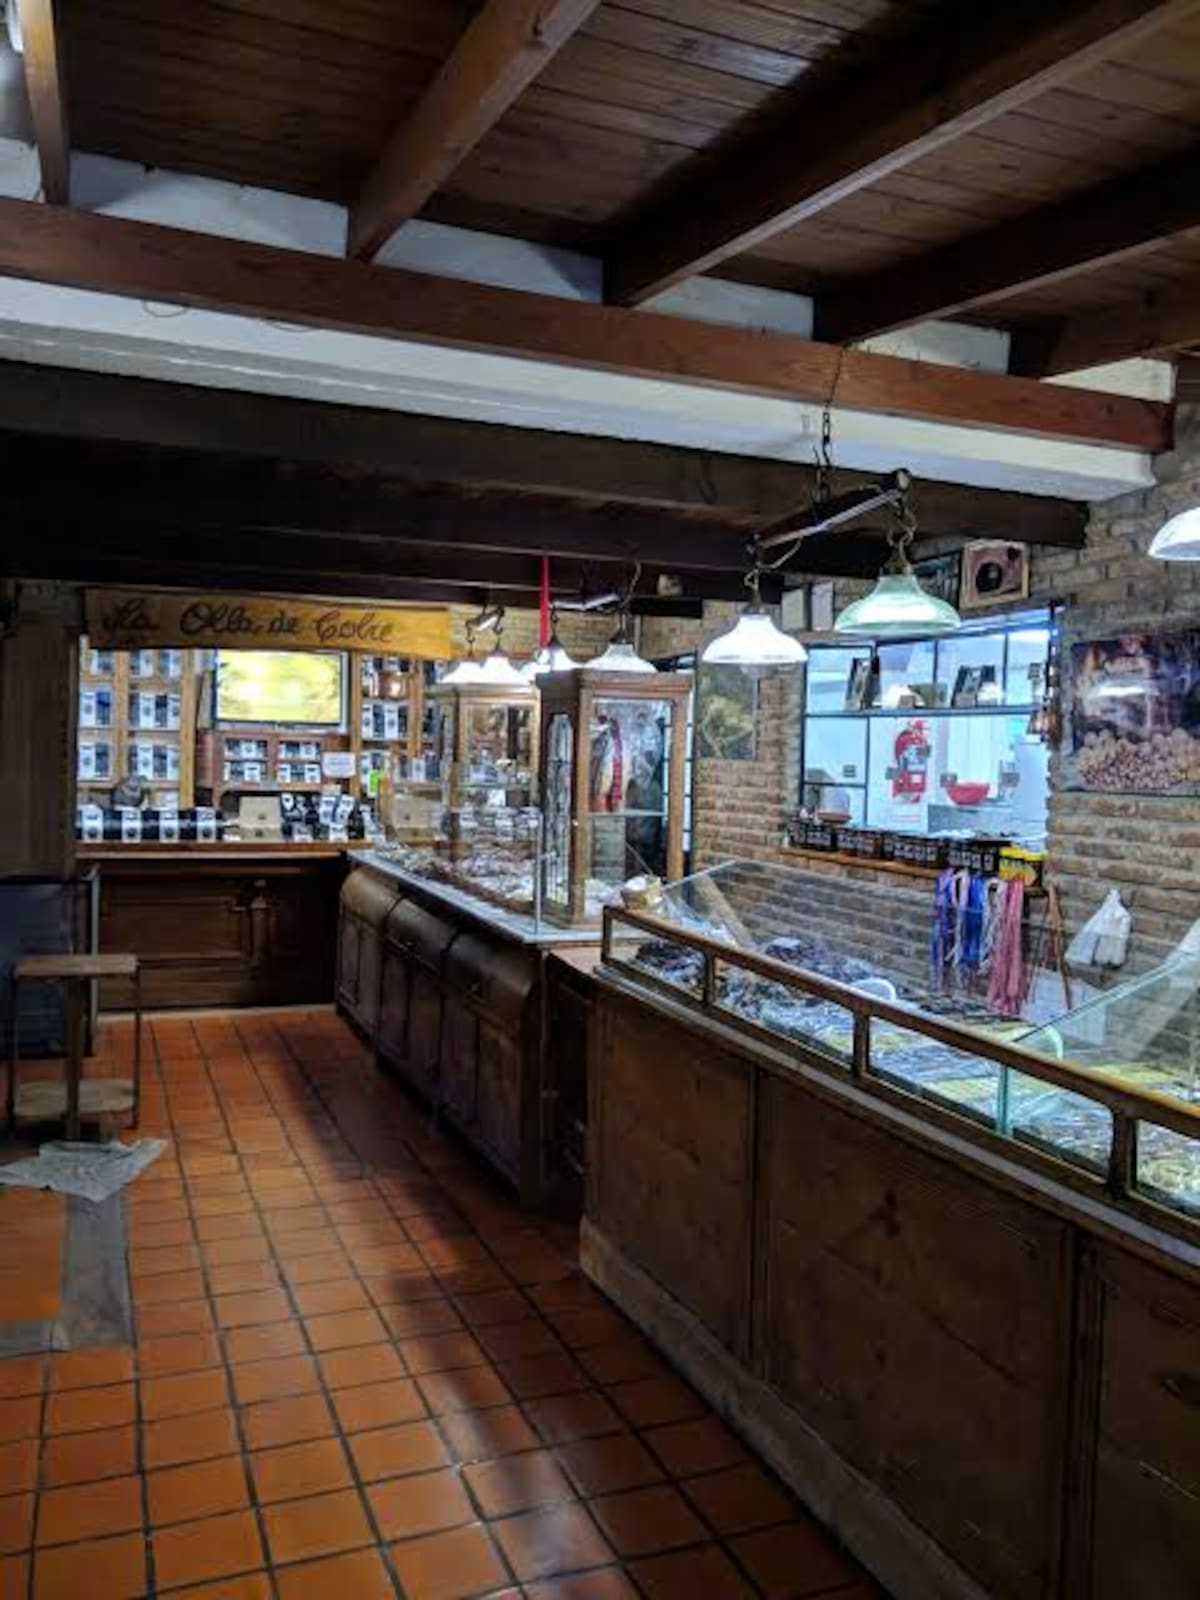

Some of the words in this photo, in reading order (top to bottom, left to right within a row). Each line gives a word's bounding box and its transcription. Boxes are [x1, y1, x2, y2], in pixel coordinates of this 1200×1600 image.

[102, 599, 160, 630] La
[180, 602, 264, 635] Olla
[267, 609, 298, 634] de
